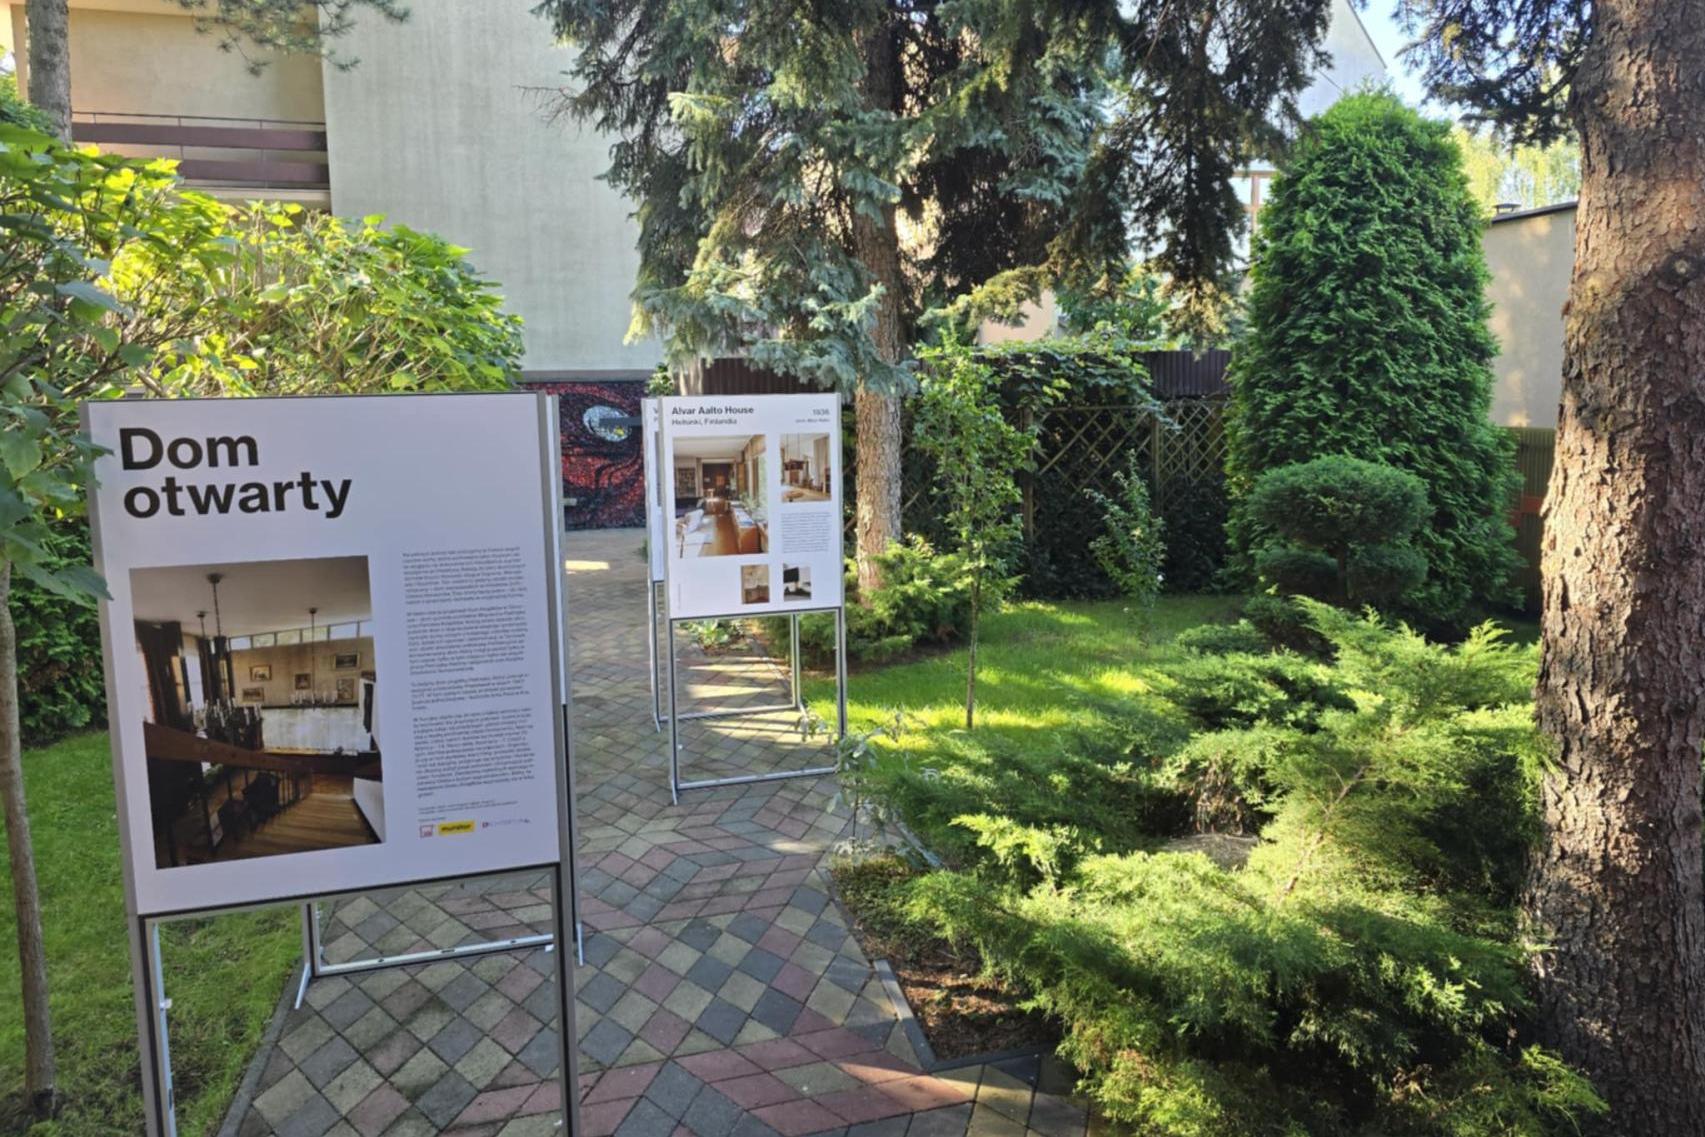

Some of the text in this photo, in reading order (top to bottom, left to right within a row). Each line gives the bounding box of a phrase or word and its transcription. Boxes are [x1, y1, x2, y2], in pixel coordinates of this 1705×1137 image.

[671, 405, 755, 415] Alvar Aalto House
[119, 427, 259, 471] Dom
[123, 471, 353, 519] otwarty
